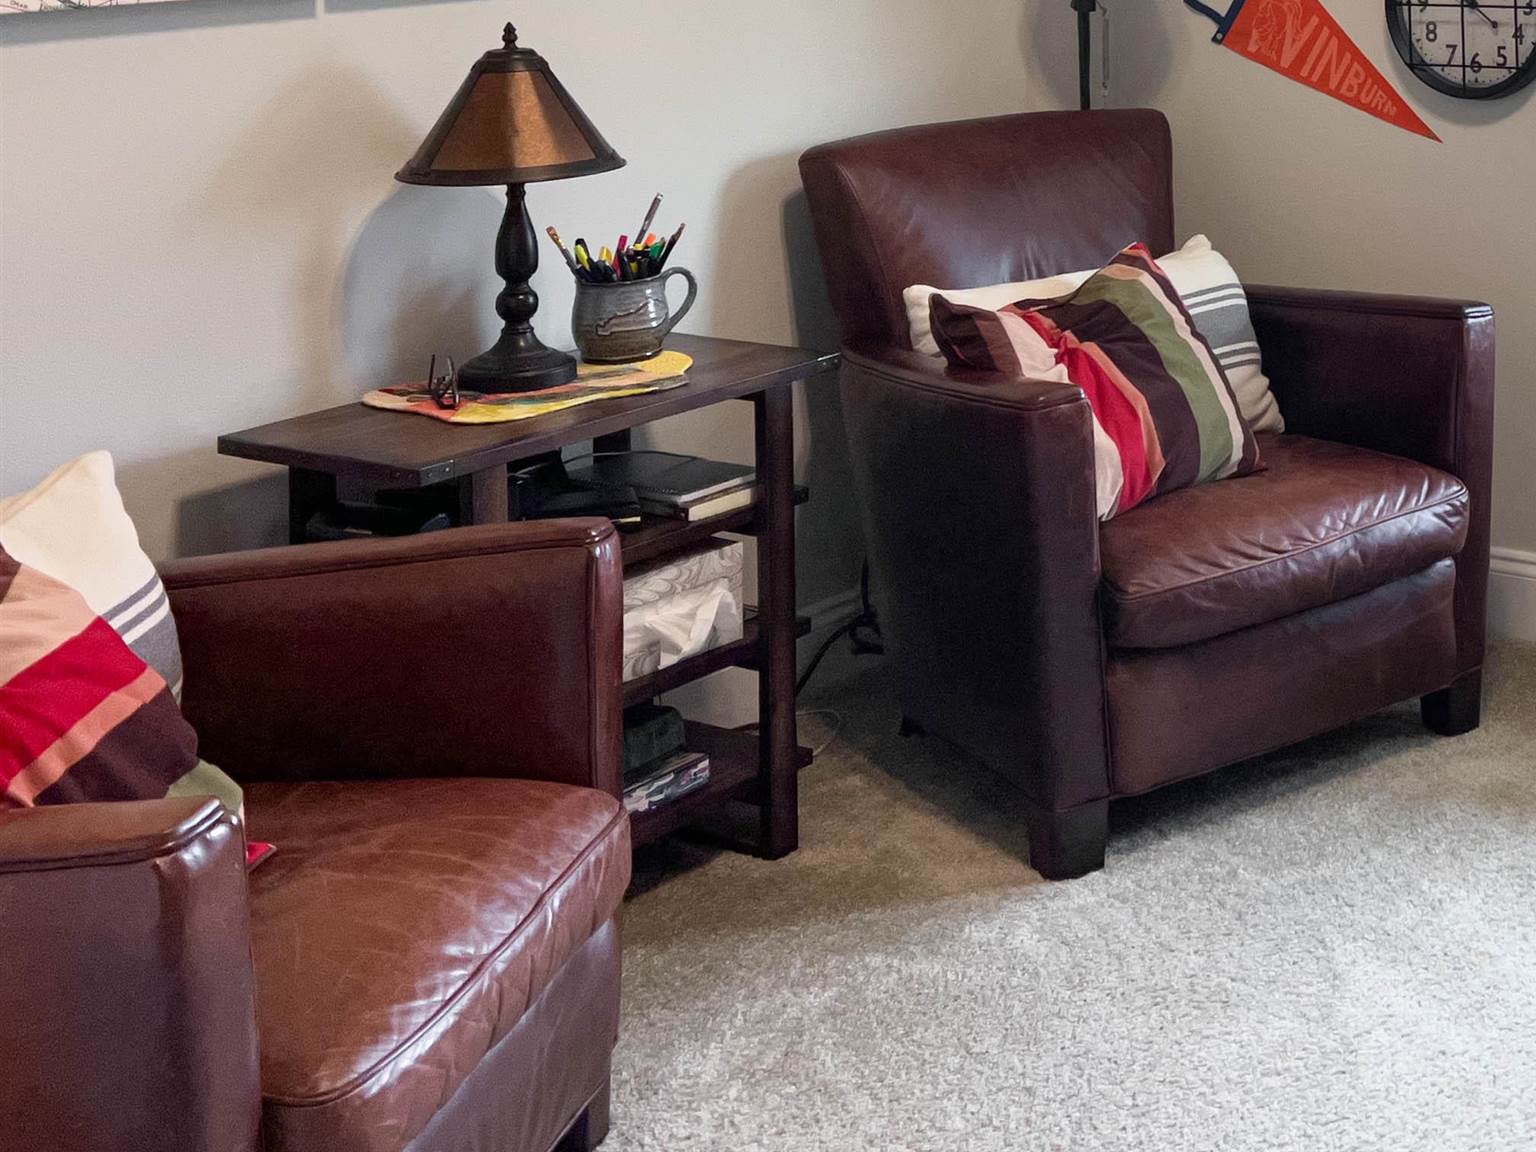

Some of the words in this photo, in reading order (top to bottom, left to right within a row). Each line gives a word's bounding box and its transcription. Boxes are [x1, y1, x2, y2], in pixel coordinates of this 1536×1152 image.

[1425, 20, 1438, 43] 8
[1512, 23, 1525, 46] 4
[1445, 43, 1459, 66] 7
[1470, 52, 1483, 74] 6
[1496, 45, 1508, 67] 5
